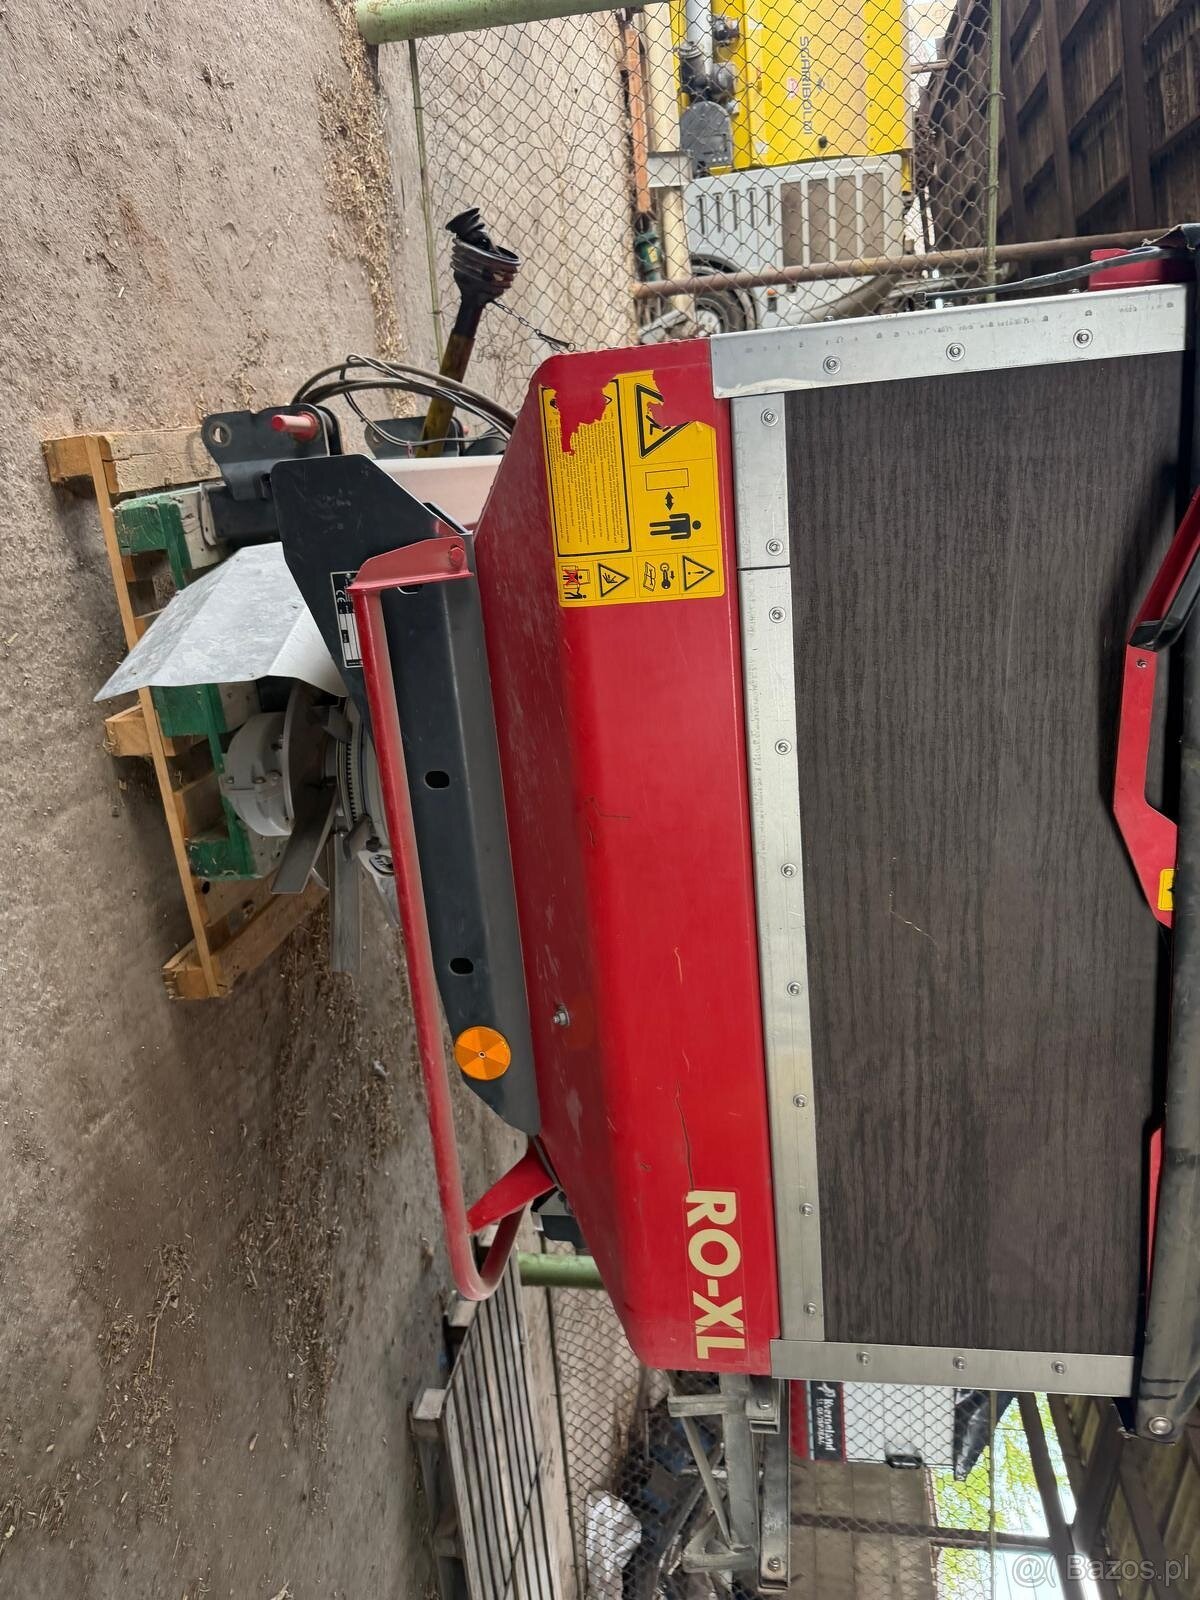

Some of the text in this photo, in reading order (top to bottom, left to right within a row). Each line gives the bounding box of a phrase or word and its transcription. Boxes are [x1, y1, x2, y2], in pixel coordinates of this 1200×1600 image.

[799, 36, 813, 135] SGARIBOLDI
[336, 590, 346, 603] CE
[685, 1190, 746, 1359] RO-XL
[824, 1399, 836, 1451] Kverneland
